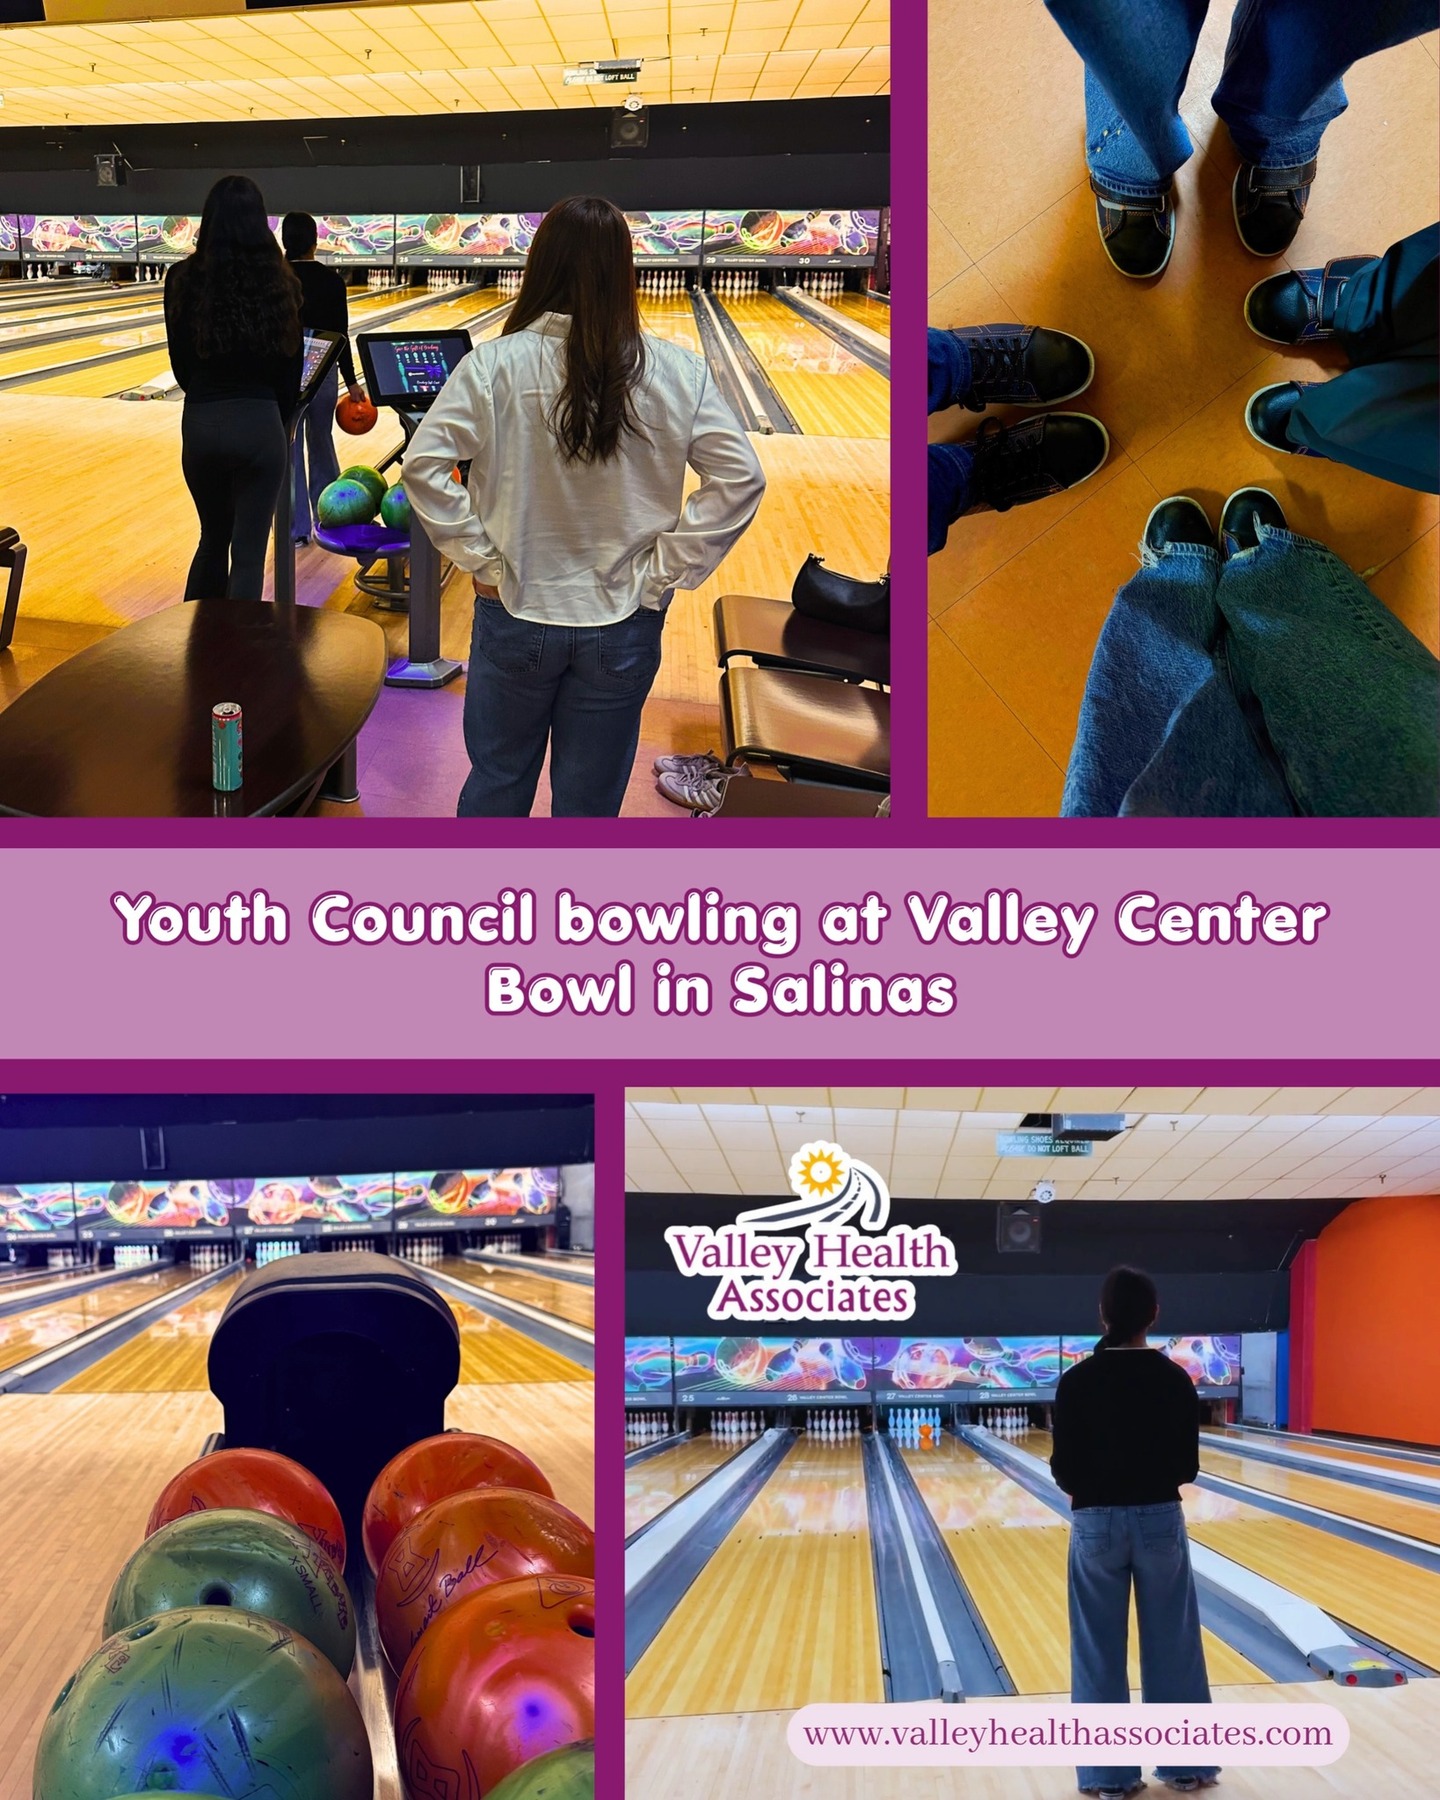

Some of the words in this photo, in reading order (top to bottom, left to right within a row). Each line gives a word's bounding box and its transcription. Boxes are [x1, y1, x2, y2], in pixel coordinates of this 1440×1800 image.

[706, 256, 717, 264] 29
[1030, 1135, 1053, 1144] SHOES
[1027, 1145, 1036, 1153] DO
[1037, 1144, 1051, 1153] NOT
[1051, 1144, 1069, 1153] LOFT
[1070, 1144, 1089, 1153] BALL
[681, 1394, 695, 1402] 25
[787, 1393, 798, 1402] 26
[886, 1392, 896, 1400] 27
[439, 1544, 499, 1598] Ball
